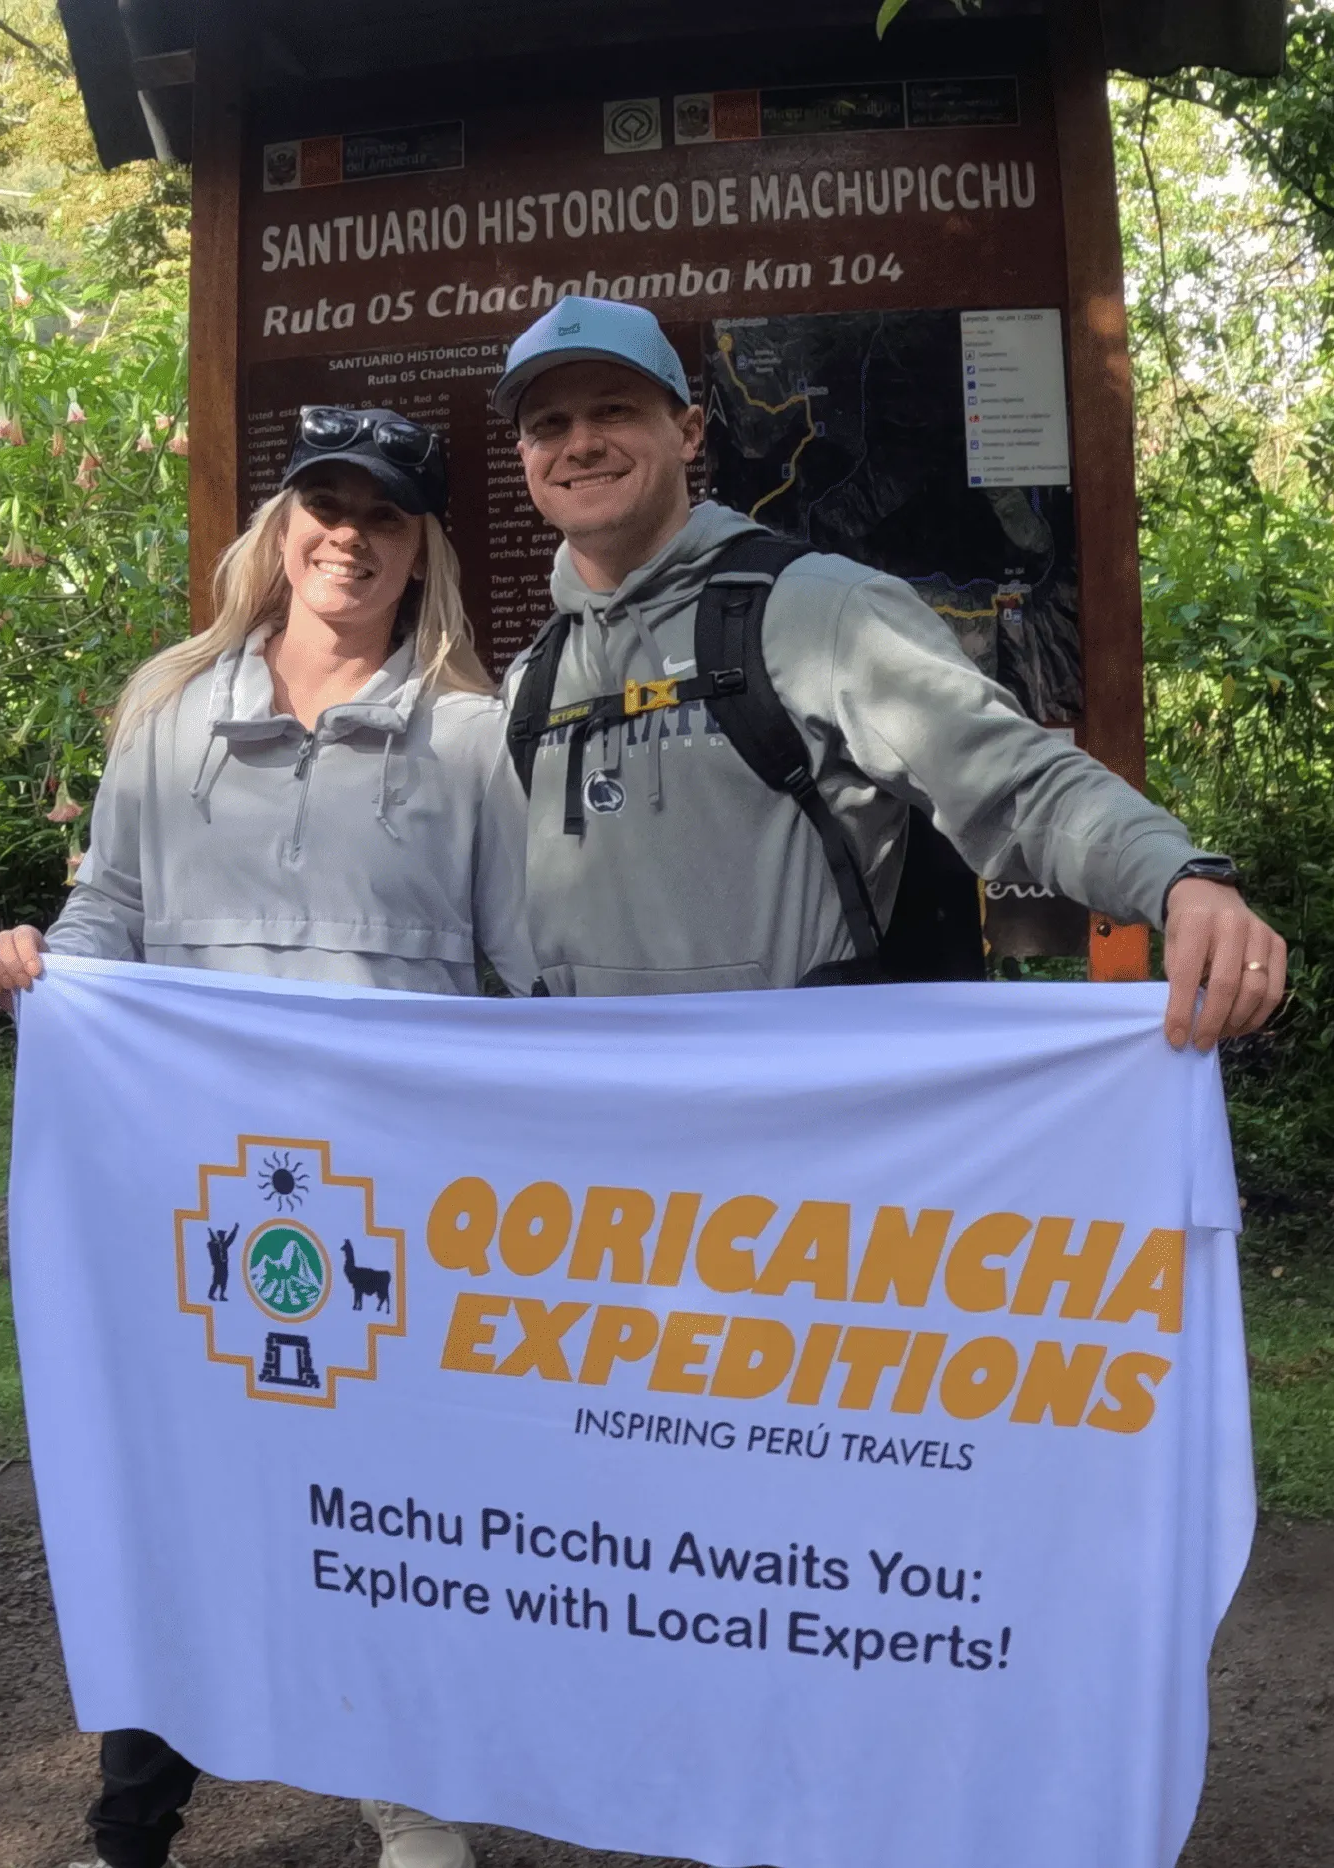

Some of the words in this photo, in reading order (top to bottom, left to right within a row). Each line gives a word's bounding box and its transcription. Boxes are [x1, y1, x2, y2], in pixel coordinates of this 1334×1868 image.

[262, 203, 467, 272] SANTUARIO
[478, 182, 678, 246] HISTORICO
[691, 177, 738, 227] DE
[750, 160, 1037, 223] MACHUPICCHU
[263, 298, 355, 338] Ruta
[367, 290, 416, 325] 05
[426, 262, 731, 318] Chachabamba
[743, 257, 812, 292] Km
[827, 251, 905, 287] 104
[328, 356, 404, 371] SANTUARIO
[407, 346, 478, 363] HISTÓRICO
[481, 344, 499, 356] DE
[367, 374, 397, 386] Ruta
[400, 370, 416, 382] 05
[420, 361, 505, 381] Chachabamb
[488, 489, 514, 500] point
[516, 488, 528, 498] to
[488, 505, 501, 514] be
[488, 519, 535, 530] evidence,
[489, 534, 507, 545] and
[489, 548, 527, 560] orchids,
[490, 574, 515, 584] Then
[519, 574, 539, 584] you
[491, 604, 514, 614] view
[516, 602, 527, 612] of
[530, 602, 547, 612] the
[491, 620, 502, 629] of
[505, 619, 521, 629] the
[492, 635, 524, 645] snowy
[427, 1176, 1185, 1334] QORICANCHA
[440, 1292, 1172, 1434] EXPEDITIONS
[575, 1408, 736, 1450] INSPIRING
[747, 1422, 831, 1459] PERÚ
[841, 1433, 975, 1471] TRAVELS
[309, 1483, 463, 1547] Machu
[481, 1507, 652, 1572] Picchu
[668, 1531, 850, 1591] Awaits
[868, 1549, 983, 1604] You:
[312, 1548, 491, 1616] Explore
[505, 1583, 609, 1633] with
[627, 1592, 768, 1651] Local
[787, 1610, 1012, 1671] Experts!
